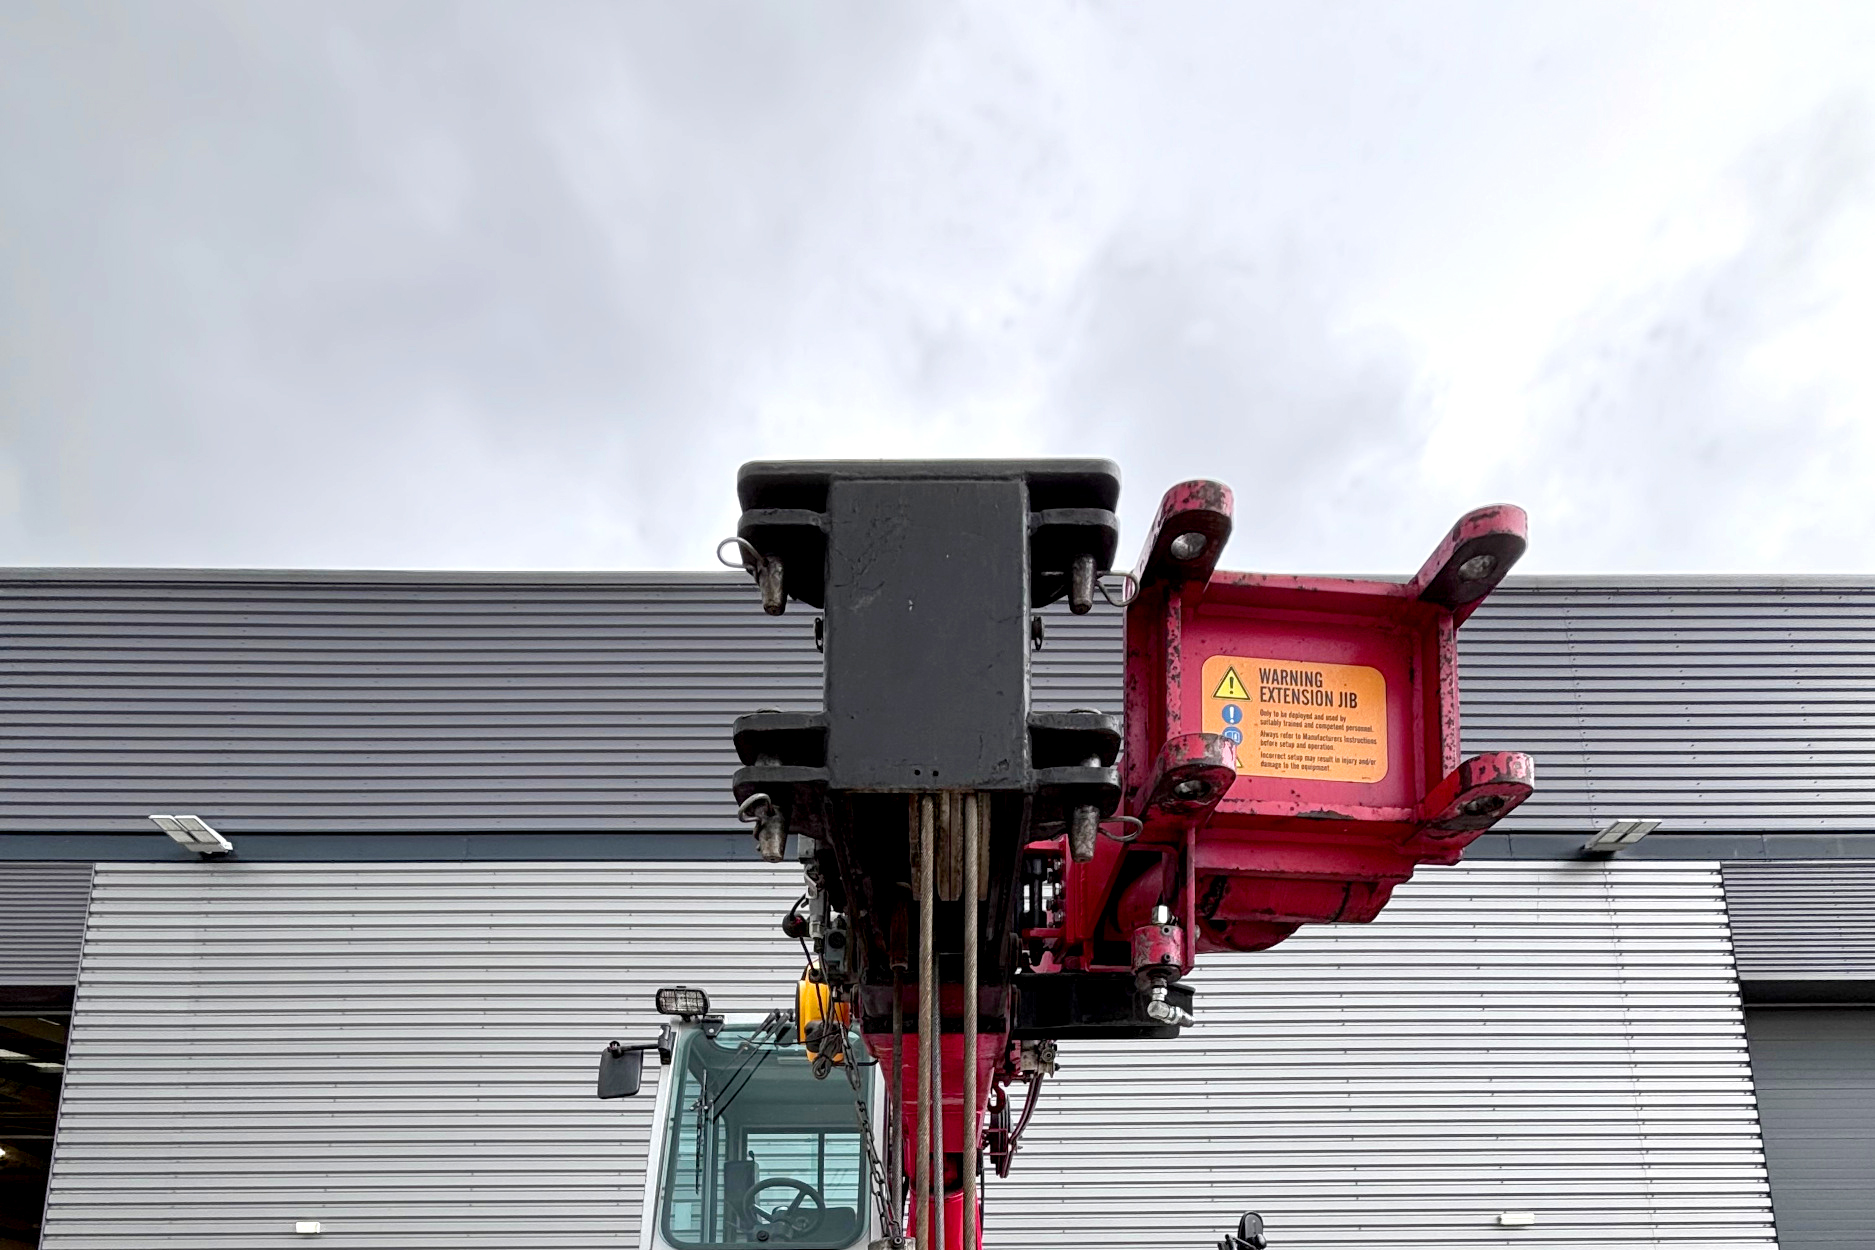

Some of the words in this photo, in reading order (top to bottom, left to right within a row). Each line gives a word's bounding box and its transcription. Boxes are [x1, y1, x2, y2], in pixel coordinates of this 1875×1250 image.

[1259, 667, 1323, 688] WARNING
[1260, 686, 1334, 707] EXTENSION
[1338, 691, 1358, 708] JIB
[1260, 709, 1271, 718] Only
[1288, 711, 1312, 720] deployed
[1339, 714, 1347, 723] by
[1260, 719, 1281, 727] suitably
[1283, 720, 1302, 728] trained
[1315, 723, 1344, 731] competent
[1260, 730, 1278, 739] Always
[1302, 733, 1343, 743] Manufacturers
[1260, 739, 1277, 747] before
[1279, 741, 1294, 749] setup
[1296, 741, 1306, 749] and
[1260, 751, 1286, 760] Incorrect
[1287, 754, 1303, 763] setup
[1341, 757, 1357, 766] injury
[1358, 758, 1376, 766] and/or
[1260, 760, 1281, 770] damage
[1283, 761, 1289, 769] to
[1290, 762, 1300, 770] the
